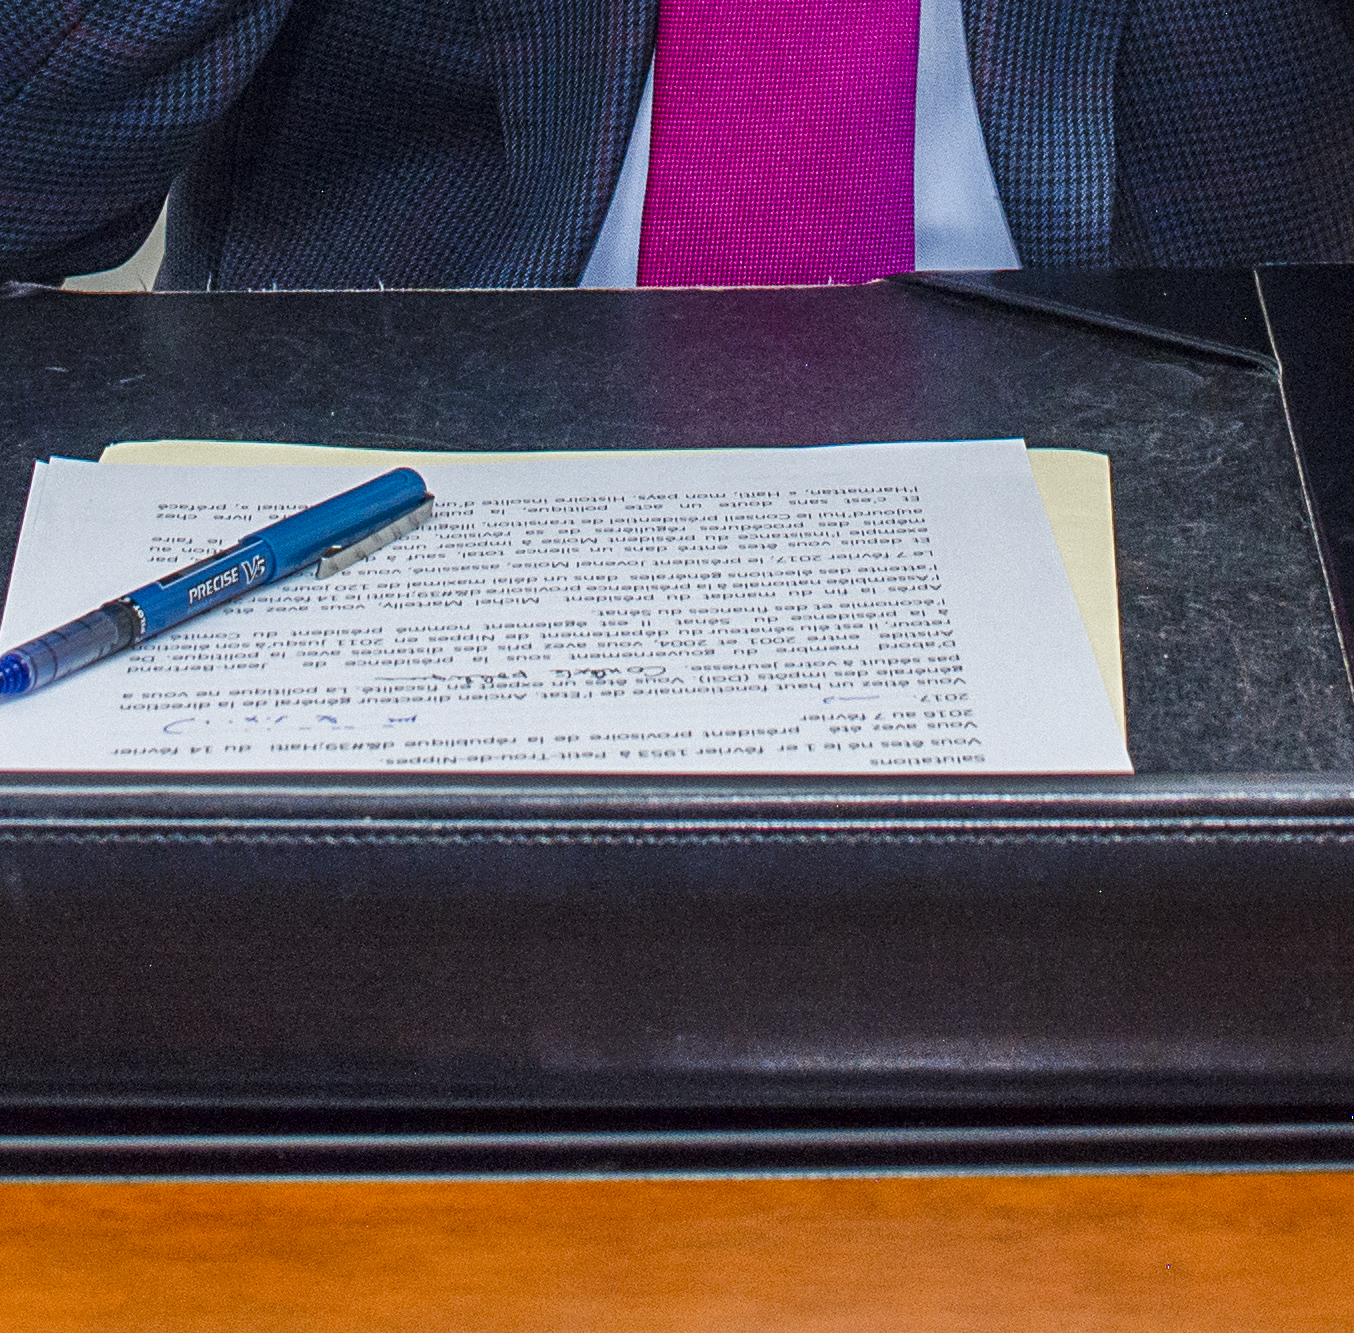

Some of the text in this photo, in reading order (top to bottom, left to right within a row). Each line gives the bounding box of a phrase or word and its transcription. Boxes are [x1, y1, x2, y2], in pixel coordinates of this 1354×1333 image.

[188, 554, 266, 604] PRECISE V5
[783, 660, 838, 669] votre
[842, 659, 854, 668] à
[859, 656, 922, 668] séduit
[927, 653, 961, 668] pas
[757, 670, 827, 682] impôts
[833, 669, 869, 679] des
[875, 664, 964, 678] générale
[479, 679, 545, 691] expert
[551, 677, 577, 688] un
[584, 676, 628, 688] êtes
[634, 675, 685, 685] Vous
[828, 680, 854, 689] un
[862, 679, 910, 689] étiez
[916, 676, 967, 686] Vous
[228, 686, 319, 697] politique
[325, 686, 348, 695] La
[446, 682, 475, 691] en
[632, 683, 768, 697] fonctionnaire
[776, 681, 822, 692] haut
[121, 692, 134, 701] a
[141, 691, 189, 700] vous
[195, 690, 221, 698] ne
[358, 694, 451, 705] directeur
[458, 692, 527, 702] Ancien
[600, 689, 626, 699] de
[119, 701, 211, 712] direction
[217, 700, 235, 710] la
[242, 699, 268, 709] de
[274, 695, 351, 709] général
[800, 708, 974, 723] 2016 au 7 février
[828, 724, 862, 736] été
[872, 722, 917, 732] avez
[926, 720, 978, 731] Vous
[589, 729, 693, 742] provisoire
[702, 725, 800, 740] président
[404, 735, 517, 749] république
[527, 736, 545, 746] la
[553, 734, 580, 745] de
[880, 739, 925, 750] êtes
[930, 737, 983, 747] Vous
[112, 746, 179, 756] février
[189, 745, 212, 755] 14
[224, 744, 252, 754] du
[696, 745, 765, 756] février
[777, 744, 799, 752] er
[806, 742, 816, 753] 1
[823, 741, 843, 752] le
[847, 740, 874, 752] né
[619, 749, 632, 759] à
[637, 747, 688, 759] 1953
[869, 754, 986, 767] Salutations
